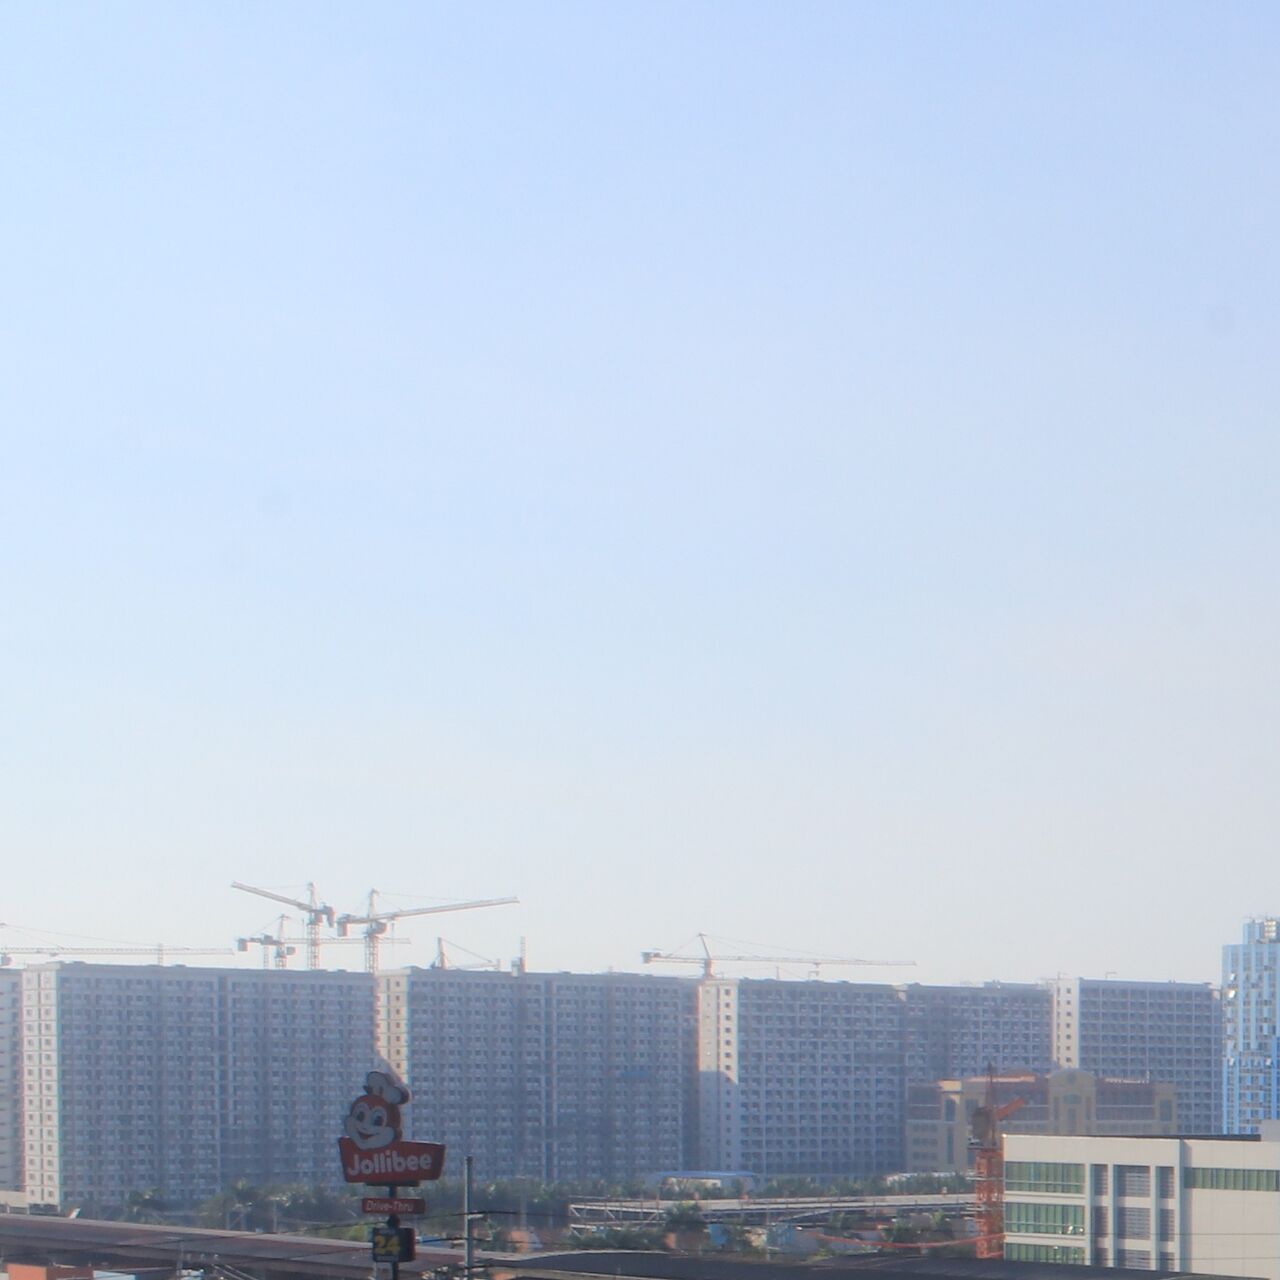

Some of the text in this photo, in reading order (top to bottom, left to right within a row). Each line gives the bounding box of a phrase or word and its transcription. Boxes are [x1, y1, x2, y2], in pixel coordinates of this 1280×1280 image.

[348, 1150, 432, 1175] Jollibee
[366, 1199, 413, 1211] Drive-Thru
[374, 1235, 400, 1255] 24
